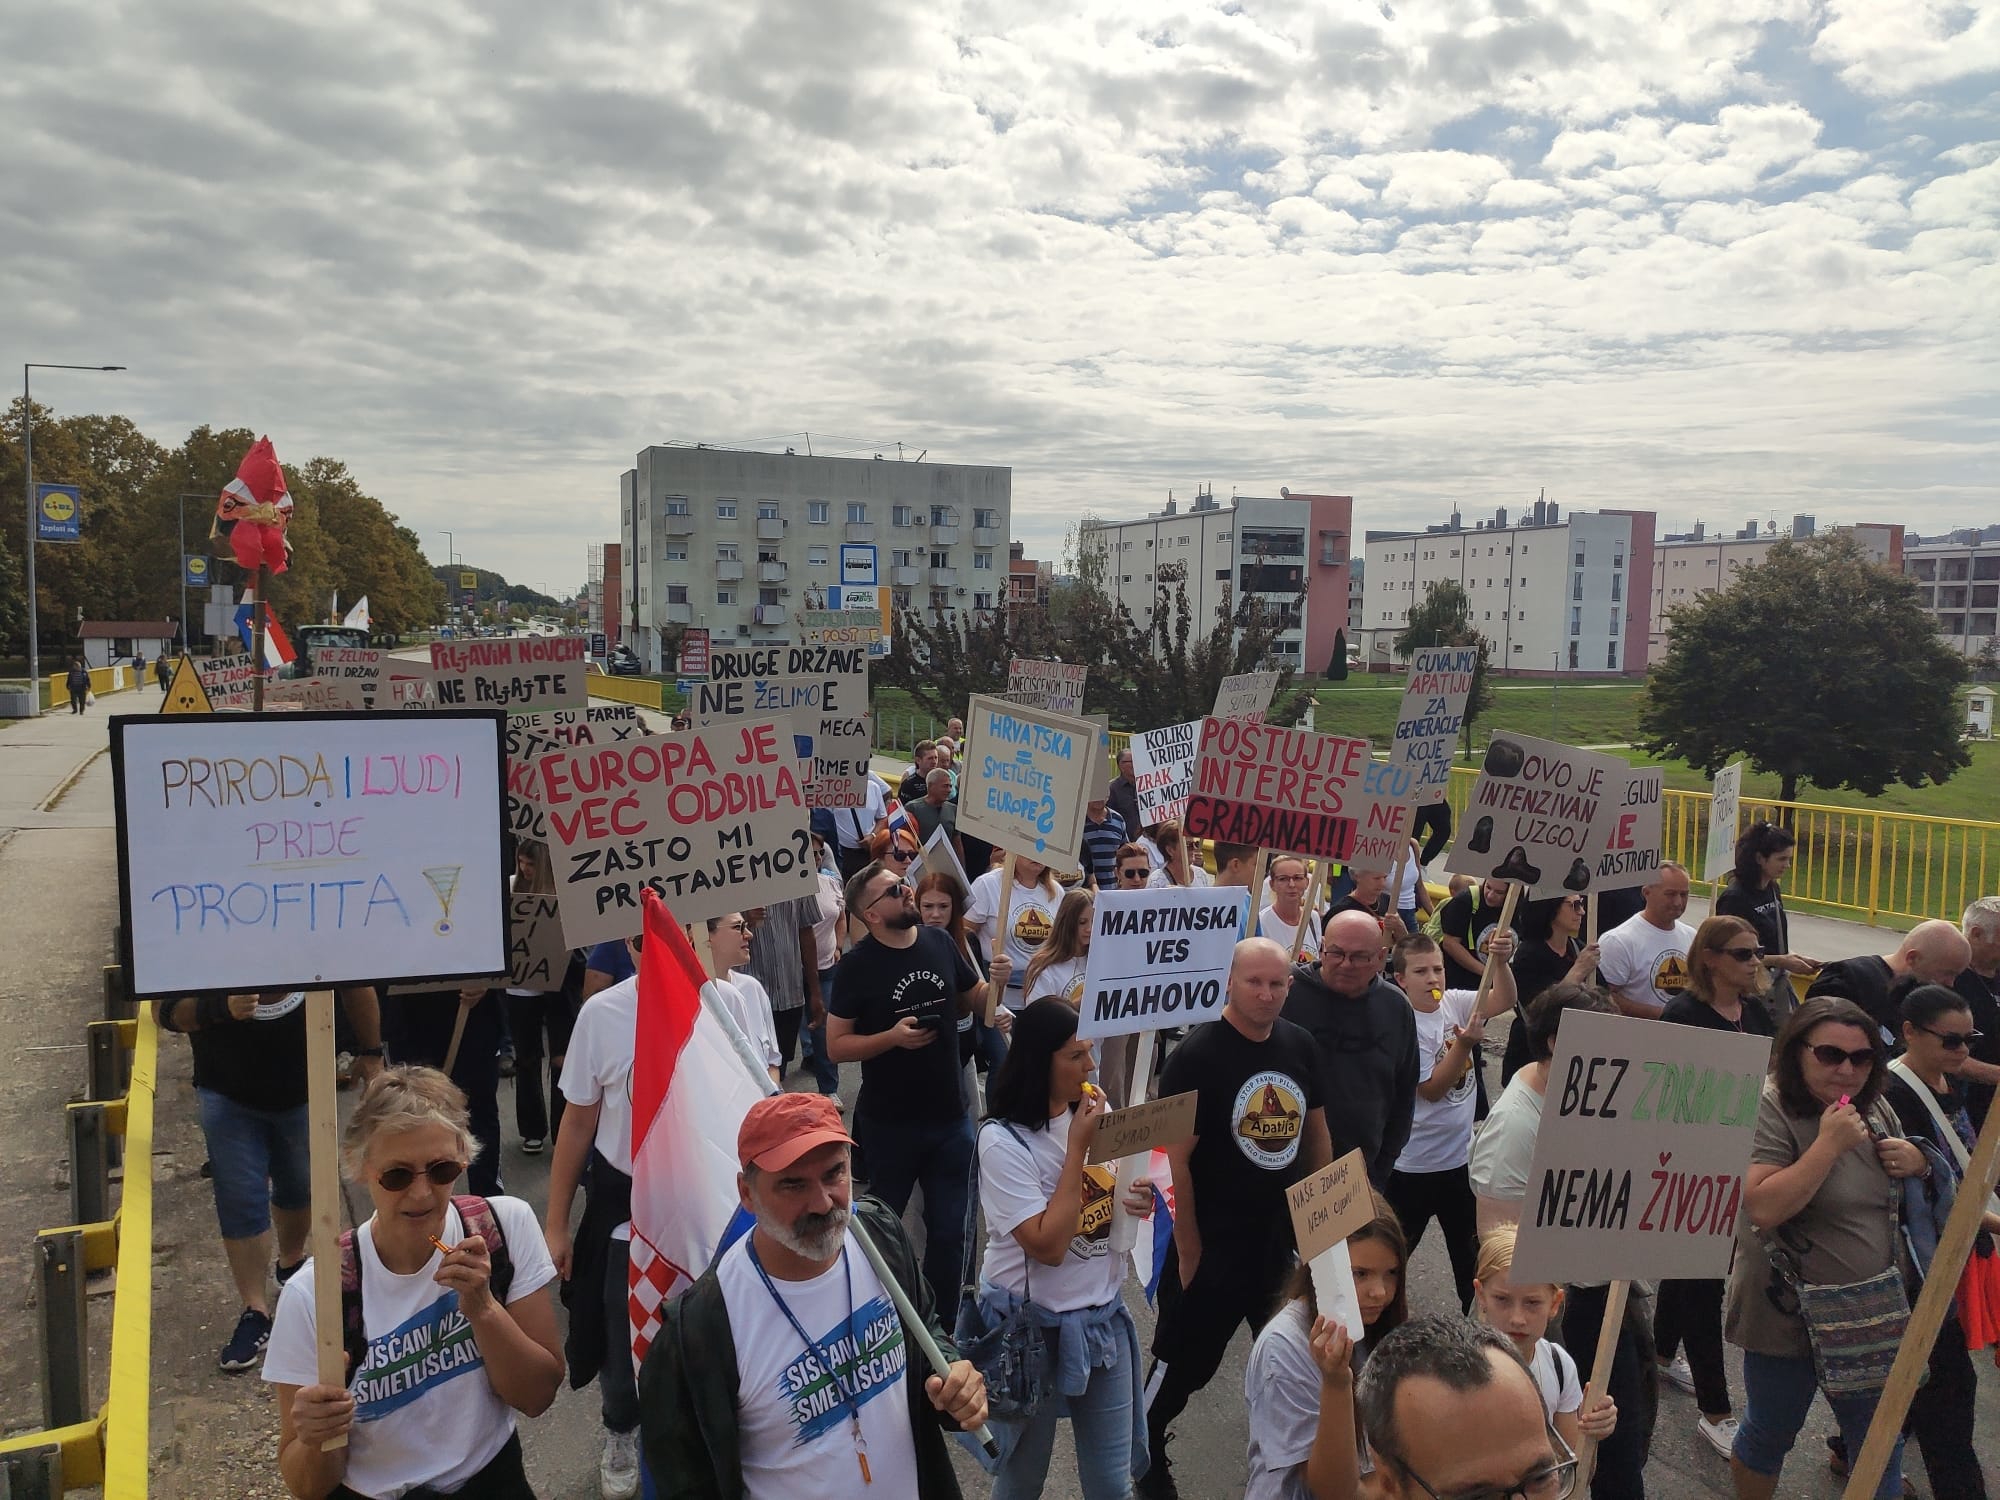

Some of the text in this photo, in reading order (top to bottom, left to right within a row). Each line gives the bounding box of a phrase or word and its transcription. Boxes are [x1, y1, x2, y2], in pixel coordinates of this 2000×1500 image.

[203, 658, 236, 672] NEMA
[320, 651, 334, 663] NE
[518, 638, 585, 663] NOVCEM
[711, 650, 781, 680] DRUGE
[788, 646, 864, 674] DRŽAVE
[202, 673, 217, 686] EZ
[204, 685, 228, 698] EMA
[392, 682, 435, 701] HRVA
[437, 680, 465, 703] NE
[1065, 681, 1085, 698] TLU
[1408, 674, 1472, 695] APATIJU
[700, 680, 820, 714] NE ŽELIMO
[1424, 696, 1446, 716] ZA
[554, 711, 575, 725] SU
[586, 706, 636, 722] FARME
[820, 718, 866, 736] MEĆA
[1396, 715, 1463, 740] GENERACIJE
[989, 713, 1072, 760] HRVATSKA
[1144, 723, 1193, 751] KOLIKO
[1201, 718, 1366, 776] POŠTUJTE
[1406, 739, 1445, 762] KOJE
[540, 724, 778, 804] EUROPA JE
[1148, 742, 1194, 768] VRIJEDI
[161, 752, 462, 809] PRIRODA I LJUDI
[814, 779, 852, 793] STOP
[983, 755, 1053, 793] SMETLIŠTE
[1135, 766, 1173, 792] ZRAK
[1199, 756, 1347, 813] INTERES
[1522, 755, 1604, 797] OVO JE
[550, 789, 648, 846] VEĆ
[667, 765, 801, 825] ODBILA
[805, 793, 867, 808] EKOCIDU
[1138, 791, 1156, 811] NE
[1479, 780, 1598, 825] INTENZIVAN
[1184, 795, 1348, 859] GRAĐANA!!!
[1367, 802, 1406, 833] NE
[246, 816, 364, 860] PRIJE
[1514, 816, 1590, 853] UZGOJ
[567, 822, 753, 884] ZAŠTO MI
[1596, 849, 1659, 877] ATASTROFU
[595, 828, 810, 916] PRISTAJEMO?
[151, 873, 411, 934] PROFITA
[1022, 926, 1049, 938] Apatija
[1101, 905, 1237, 936] MARTINSKA
[1146, 938, 1190, 965] VES
[892, 970, 945, 1001] HILFIGER
[1094, 979, 1220, 1021] MAHOVO
[1240, 1082, 1254, 1100] STOP
[1560, 1056, 1630, 1118] BEZ
[1250, 1120, 1295, 1136] Apatija
[1292, 1182, 1315, 1211] NAŠE
[1536, 1152, 1741, 1237] NEMA ŽIVOTA
[1307, 1207, 1328, 1235] NEMA
[439, 1310, 467, 1341] NIS
[864, 1313, 893, 1348] NISU
[356, 1338, 482, 1404] SMETLIŠĆAN
